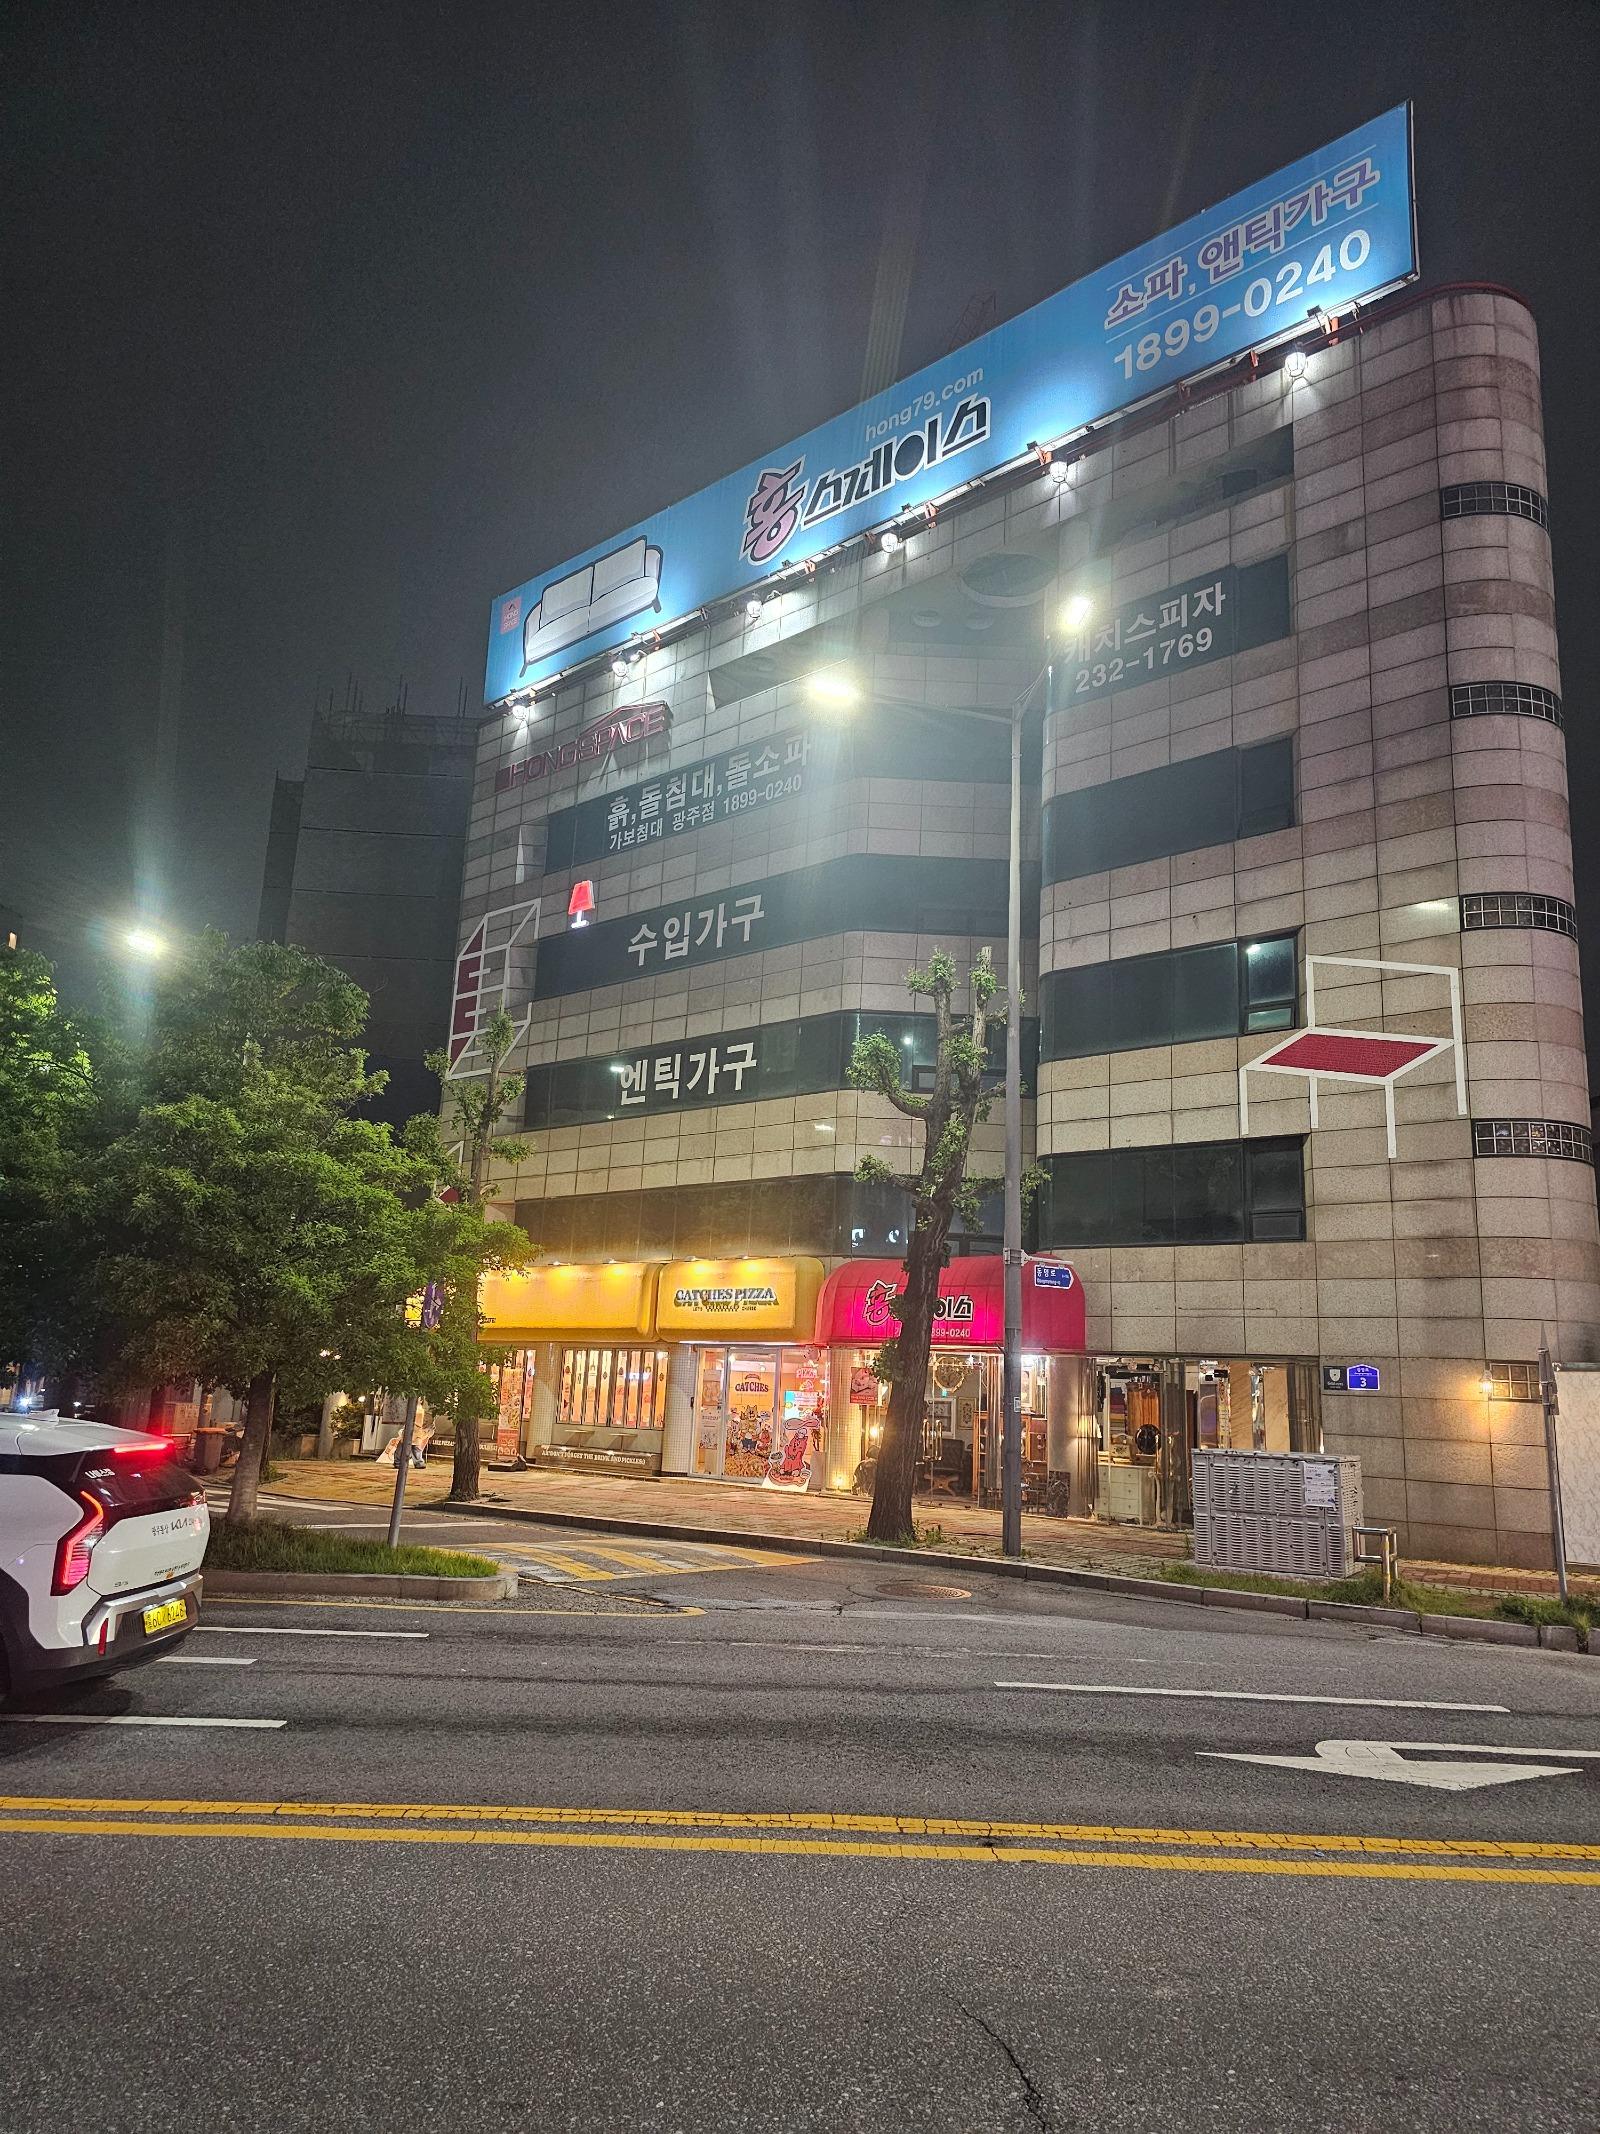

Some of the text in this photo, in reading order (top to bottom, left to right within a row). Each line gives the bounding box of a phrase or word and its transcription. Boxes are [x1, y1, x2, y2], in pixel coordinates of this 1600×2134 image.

[1104, 158, 1380, 330] 소파, 앤틱가구
[1114, 229, 1371, 380] 1899-0240
[865, 367, 985, 442] hong79.com
[1075, 627, 1213, 694] 232-1769
[609, 773, 802, 850] 가보침대 광주점 1899-0240
[627, 894, 765, 967] 수입가구
[620, 1042, 758, 1106] 엔틱가구
[735, 1287, 775, 1301] PIZZA
[931, 1327, 971, 1338] 899-0240
[735, 1381, 769, 1393] CATCHES
[1360, 1377, 1367, 1388] 3
